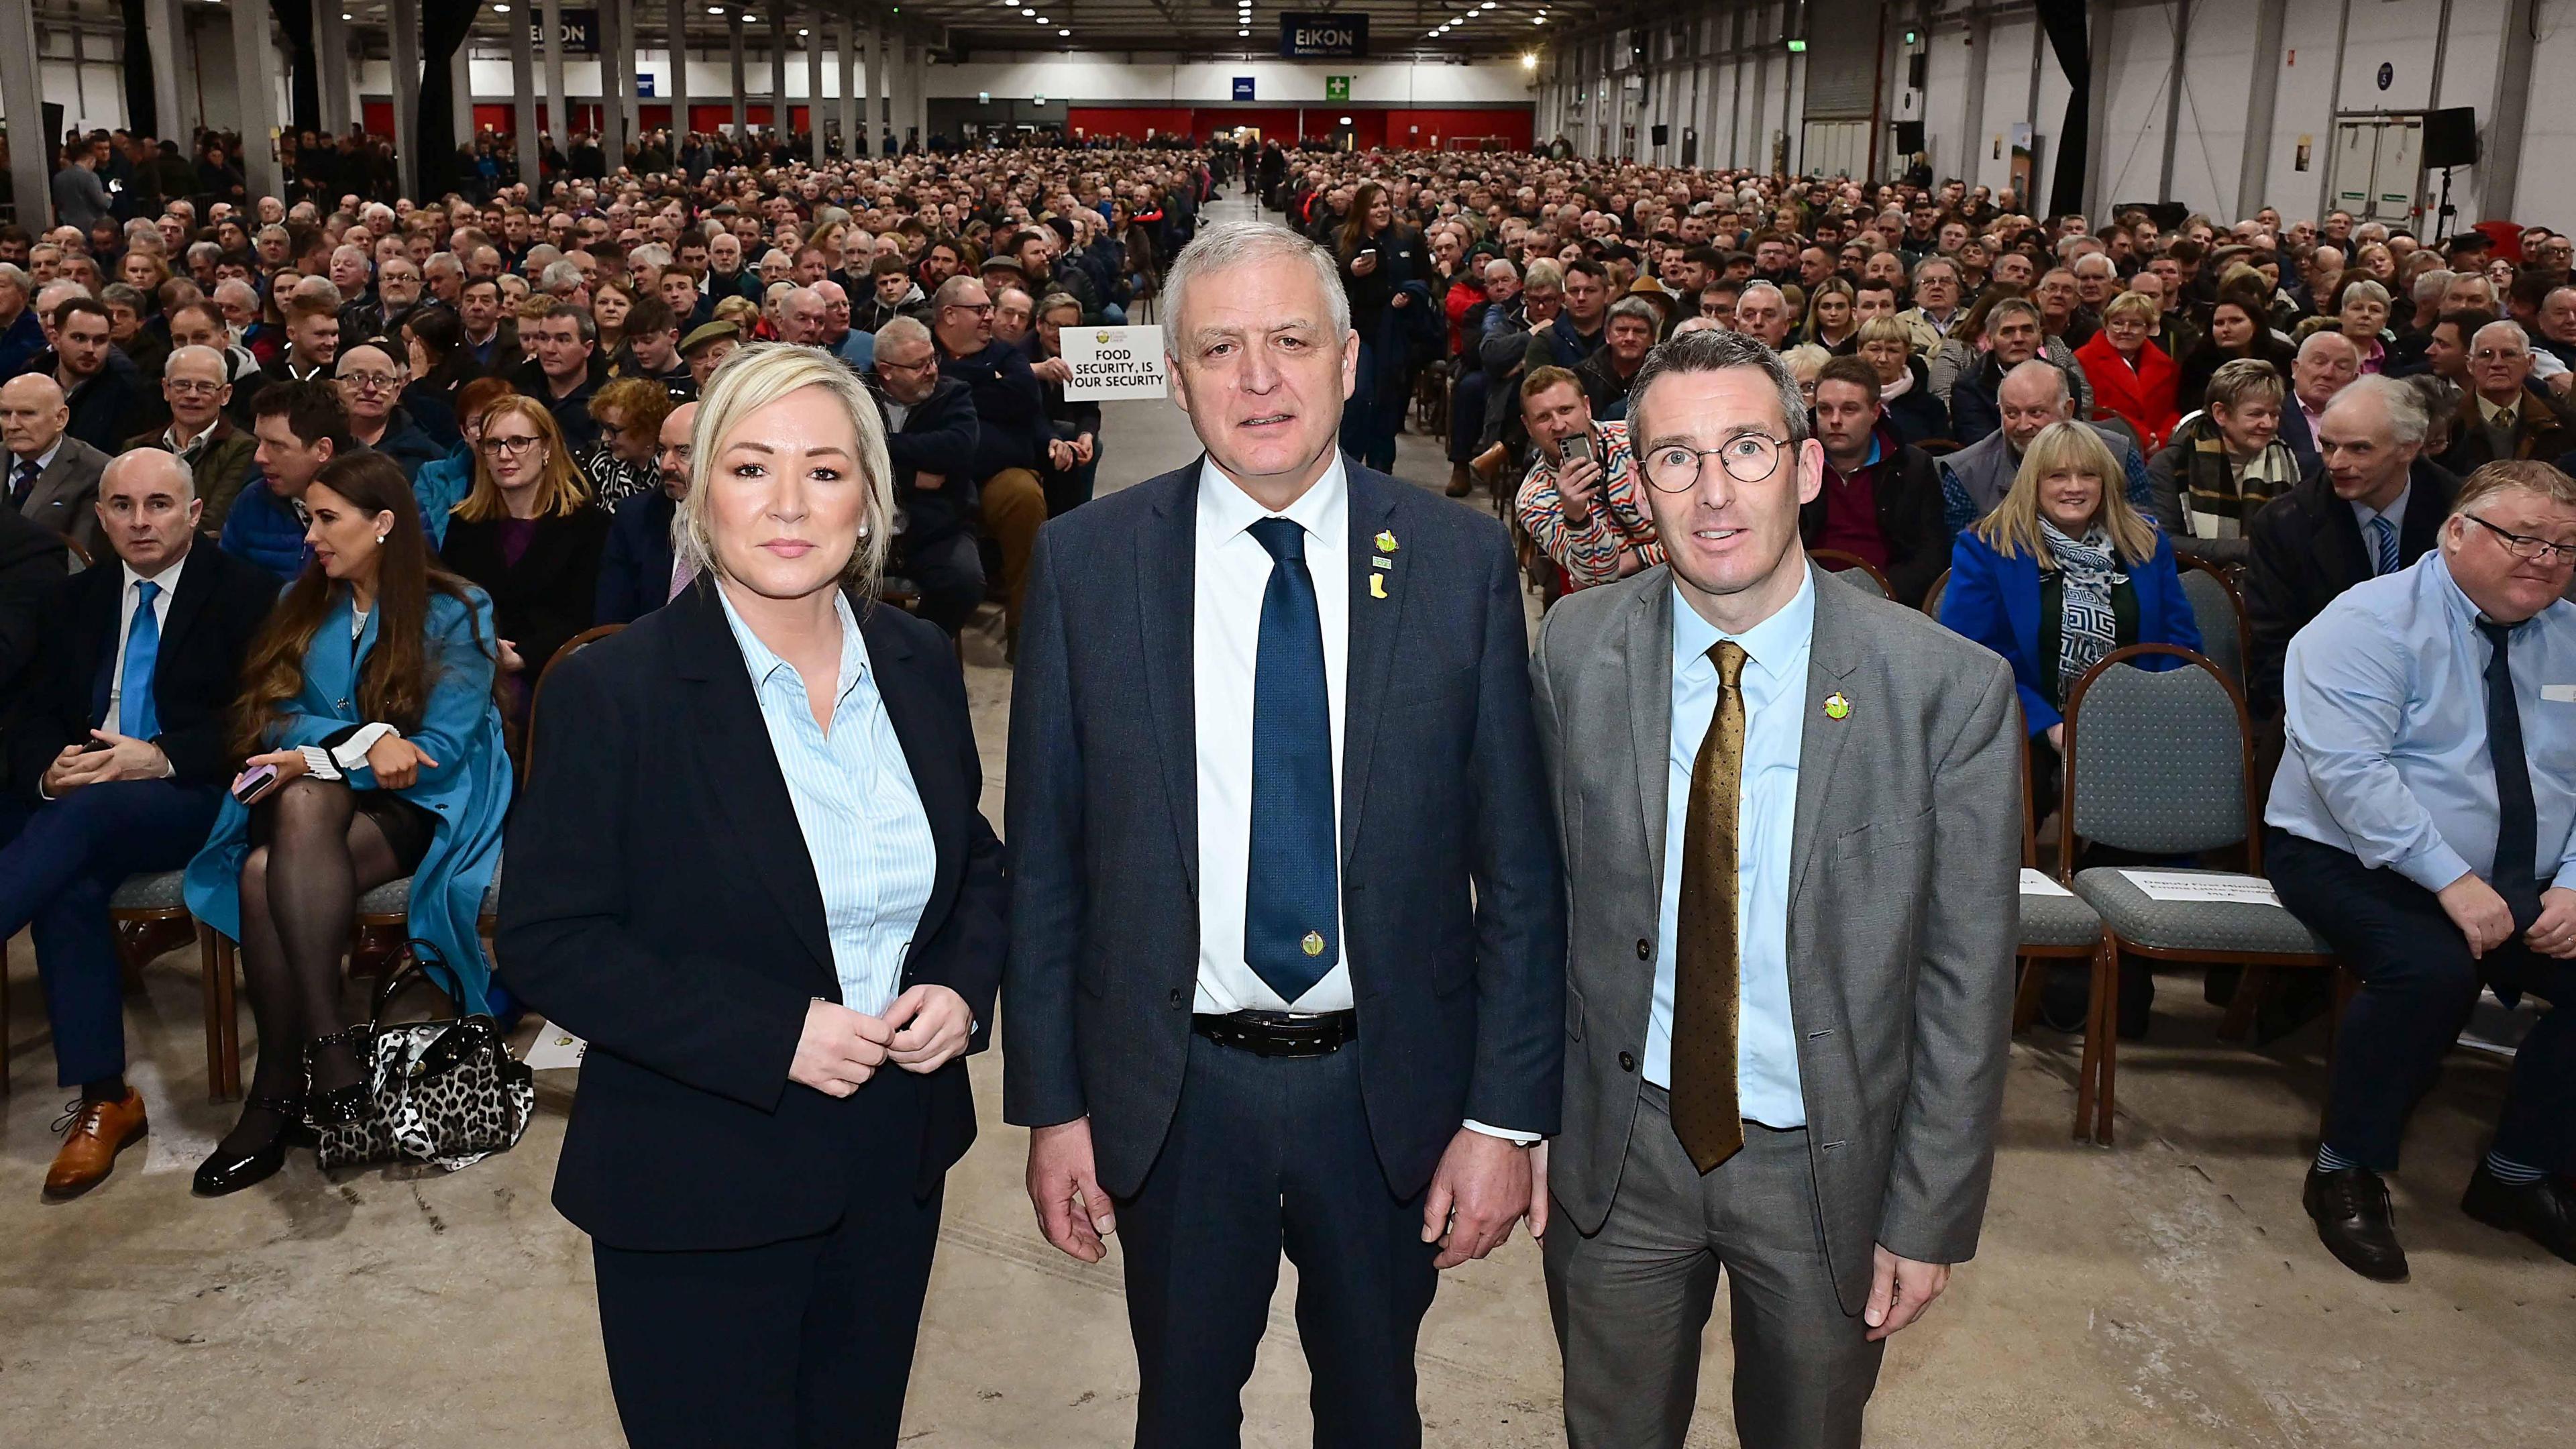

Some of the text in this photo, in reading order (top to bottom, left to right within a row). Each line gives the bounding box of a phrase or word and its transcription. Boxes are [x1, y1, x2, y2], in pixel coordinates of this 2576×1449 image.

[530, 25, 585, 42] EION
[1295, 29, 1352, 46] EIKON
[1095, 350, 1131, 360] FOOD
[1076, 362, 1153, 374] SECURITY, IS
[1106, 374, 1164, 387] SECURITY
